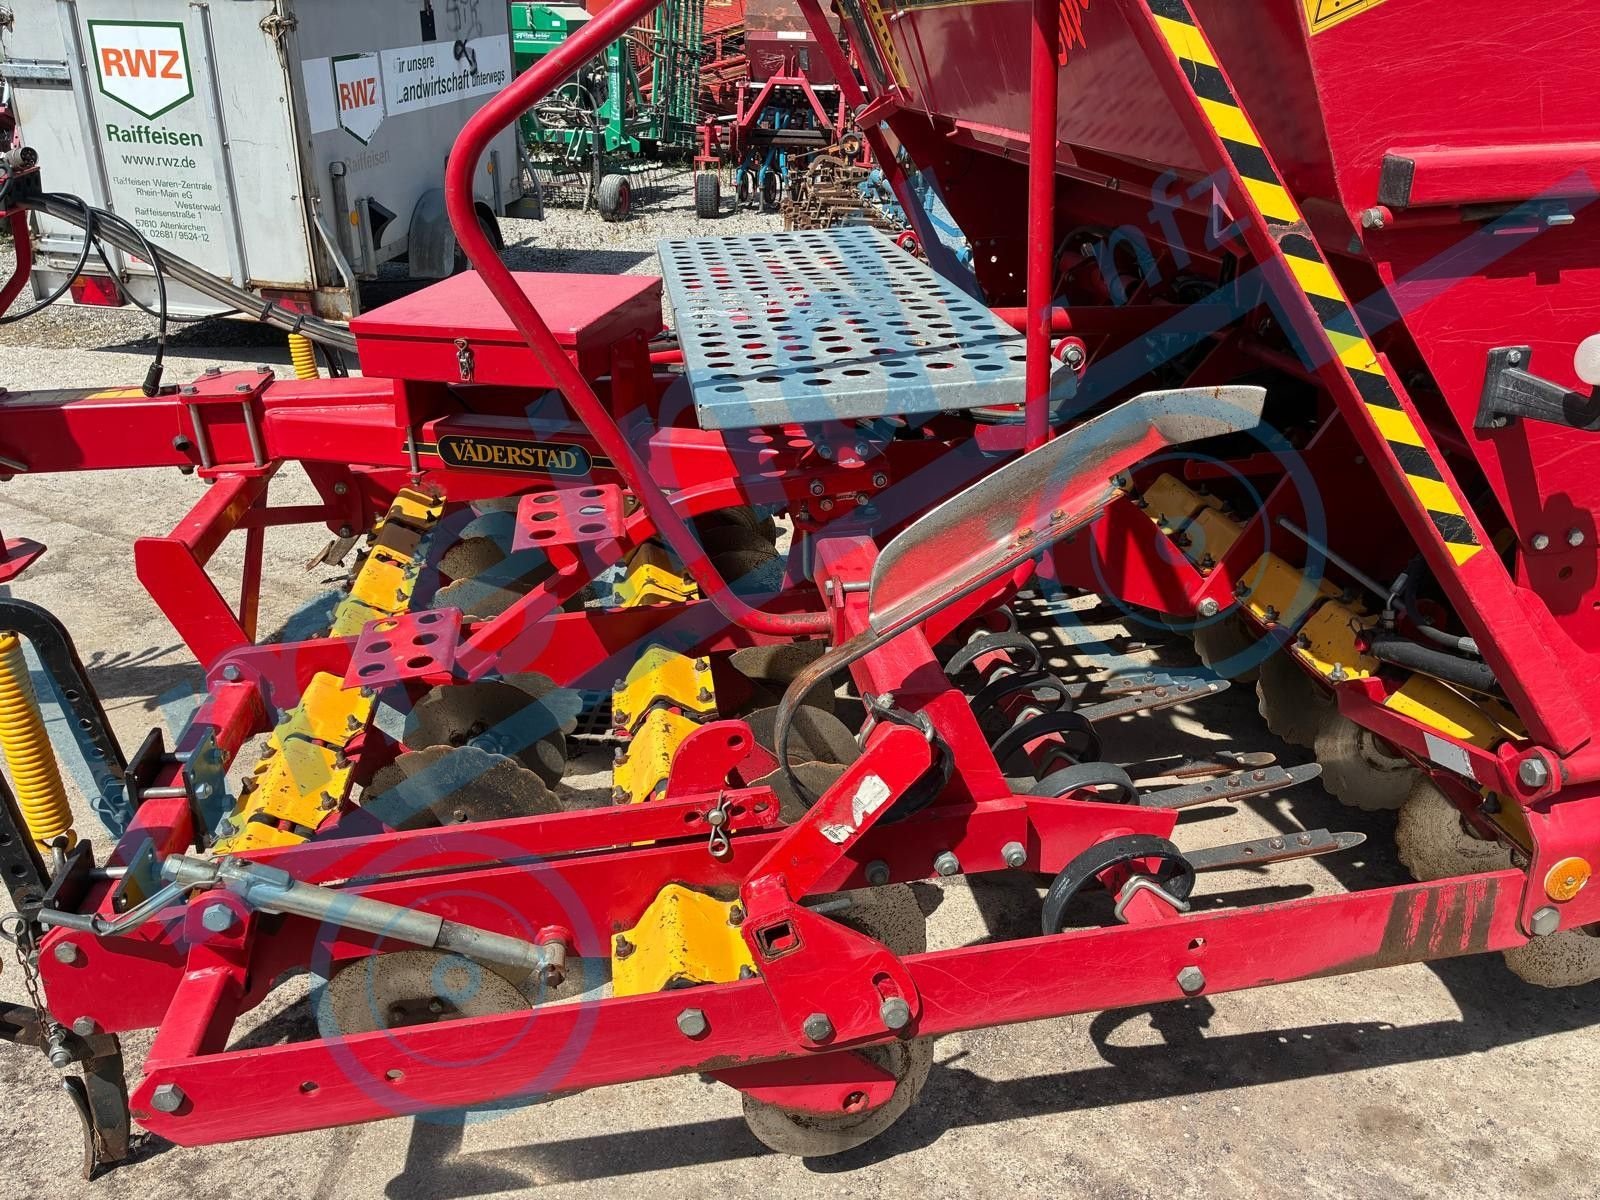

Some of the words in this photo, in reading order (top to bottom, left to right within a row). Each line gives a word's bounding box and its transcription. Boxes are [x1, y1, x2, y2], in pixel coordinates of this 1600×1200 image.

[101, 48, 183, 79] RWZ
[407, 56, 434, 72] unsere
[397, 69, 470, 104] andwirtschaft
[339, 78, 377, 111] RWZ
[106, 124, 203, 147] Raiffeisen
[121, 154, 196, 168] www.rwz.de
[113, 176, 151, 186] Raiffeisen
[152, 178, 212, 191] Waren-Zentrale
[136, 187, 180, 198] Rhein-Main
[181, 191, 193, 200] eG
[135, 207, 196, 219] Raiffeisenstraße
[174, 200, 221, 212] Westerwald
[160, 221, 206, 232] Altenkirchen
[449, 439, 577, 469] VÄDERSTAD
